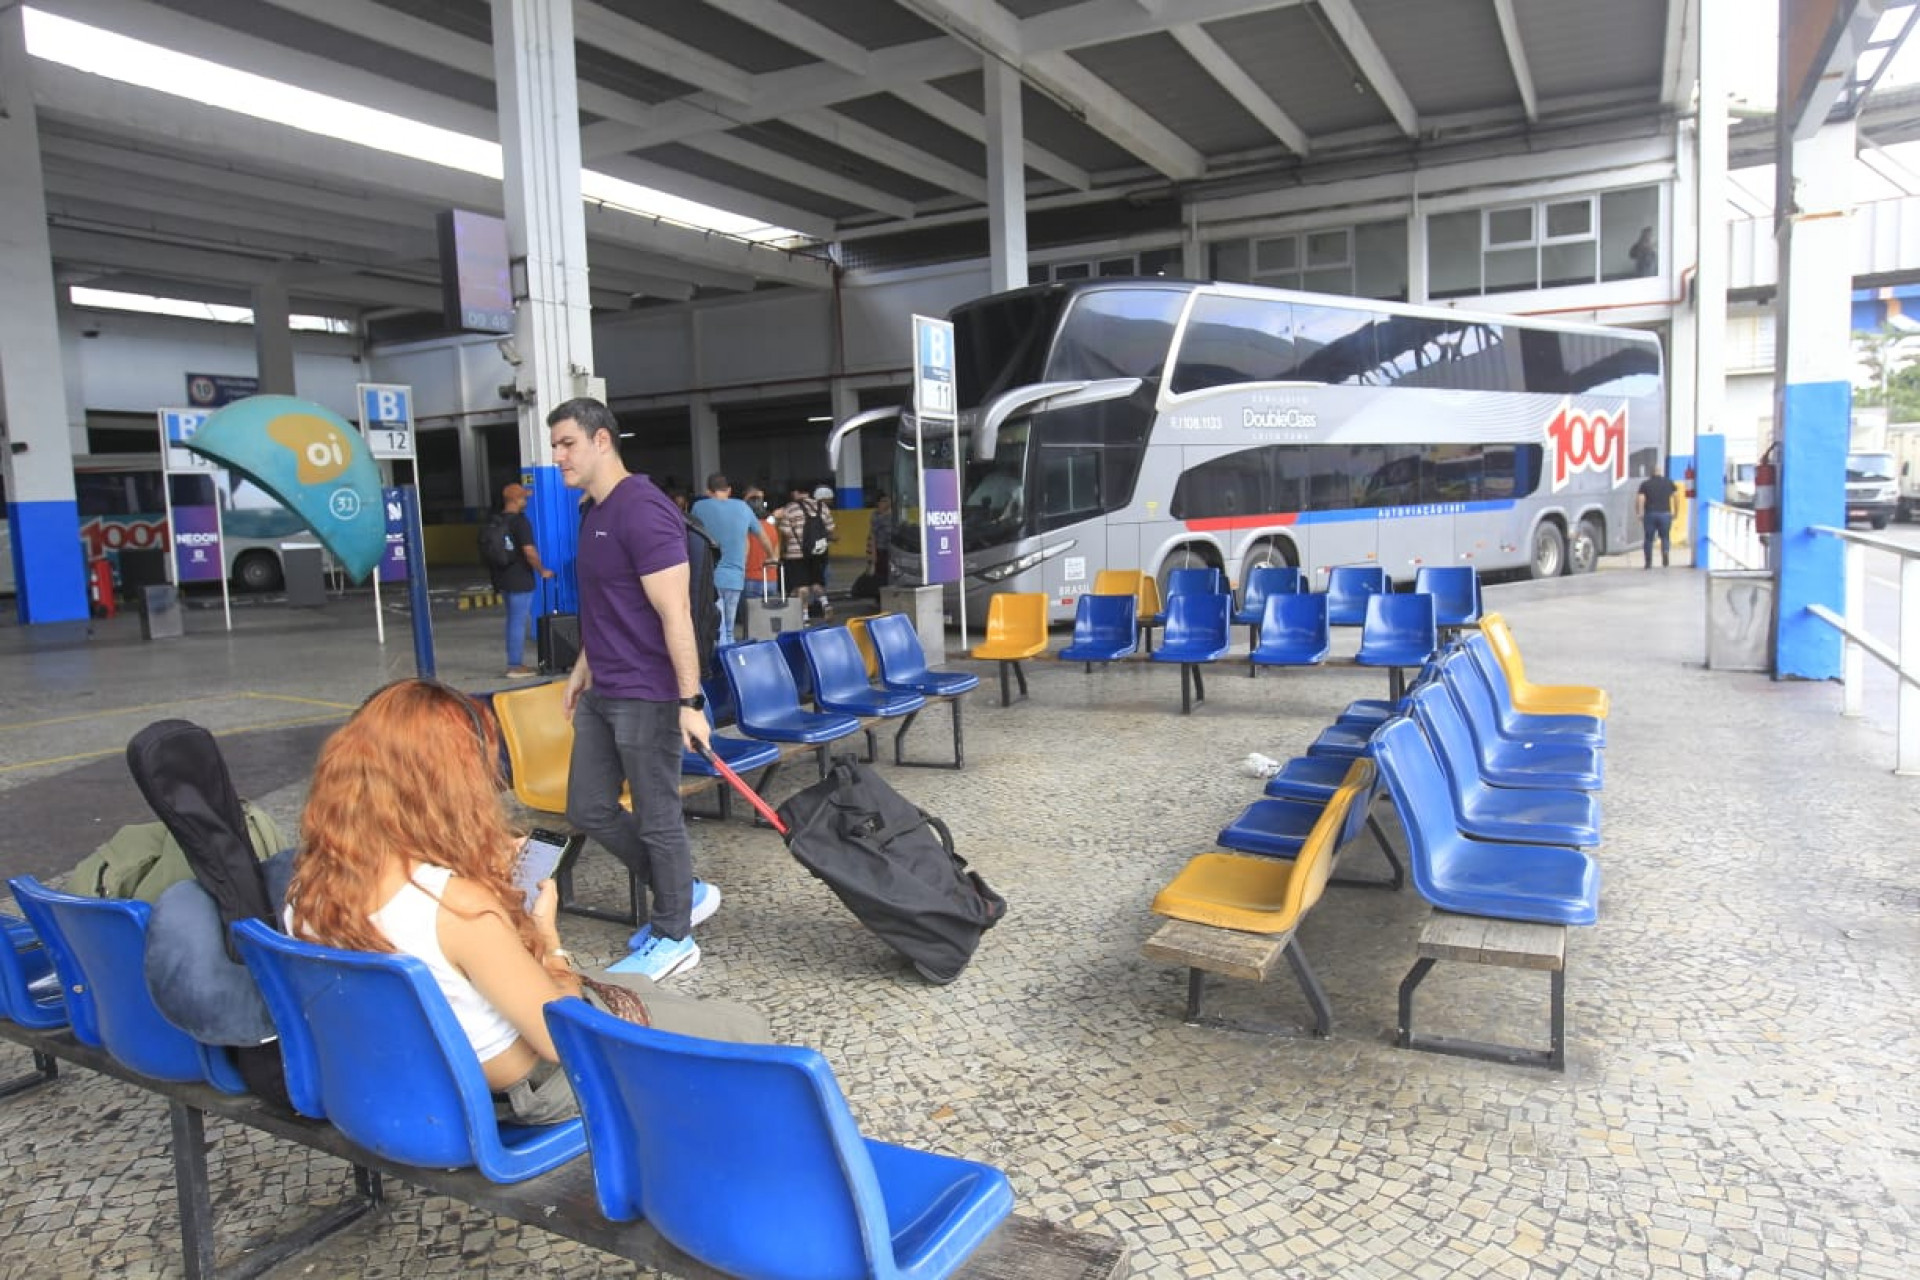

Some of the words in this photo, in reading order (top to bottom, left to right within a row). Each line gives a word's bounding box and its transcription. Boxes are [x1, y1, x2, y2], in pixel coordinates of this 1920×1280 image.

[930, 327, 947, 368] B
[378, 390, 400, 421] B
[936, 386, 951, 407] 11
[306, 432, 343, 467] oi
[387, 432, 407, 449] 12
[1545, 398, 1628, 492] 1001
[336, 496, 354, 512] 31
[81, 515, 169, 558] 1001
